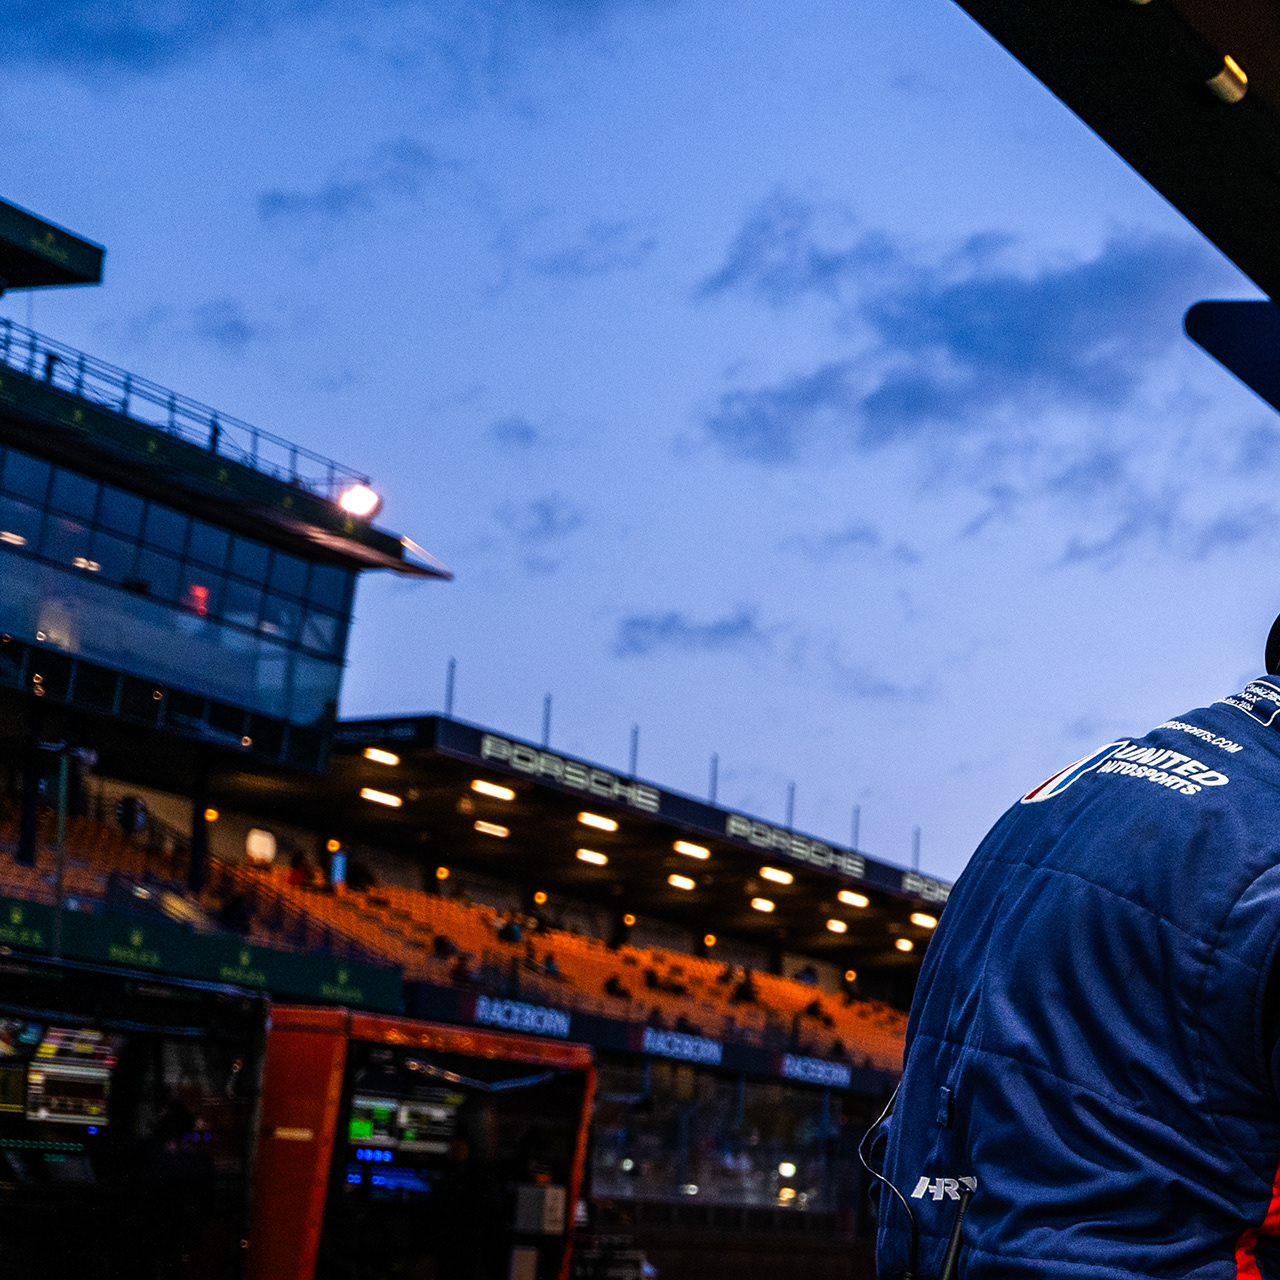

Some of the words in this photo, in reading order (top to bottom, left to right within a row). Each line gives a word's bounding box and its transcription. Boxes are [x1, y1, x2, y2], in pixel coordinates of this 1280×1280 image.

[480, 732, 660, 813] PORSCHE
[1114, 745, 1229, 786] UNITED
[725, 812, 866, 879] PORSCHE
